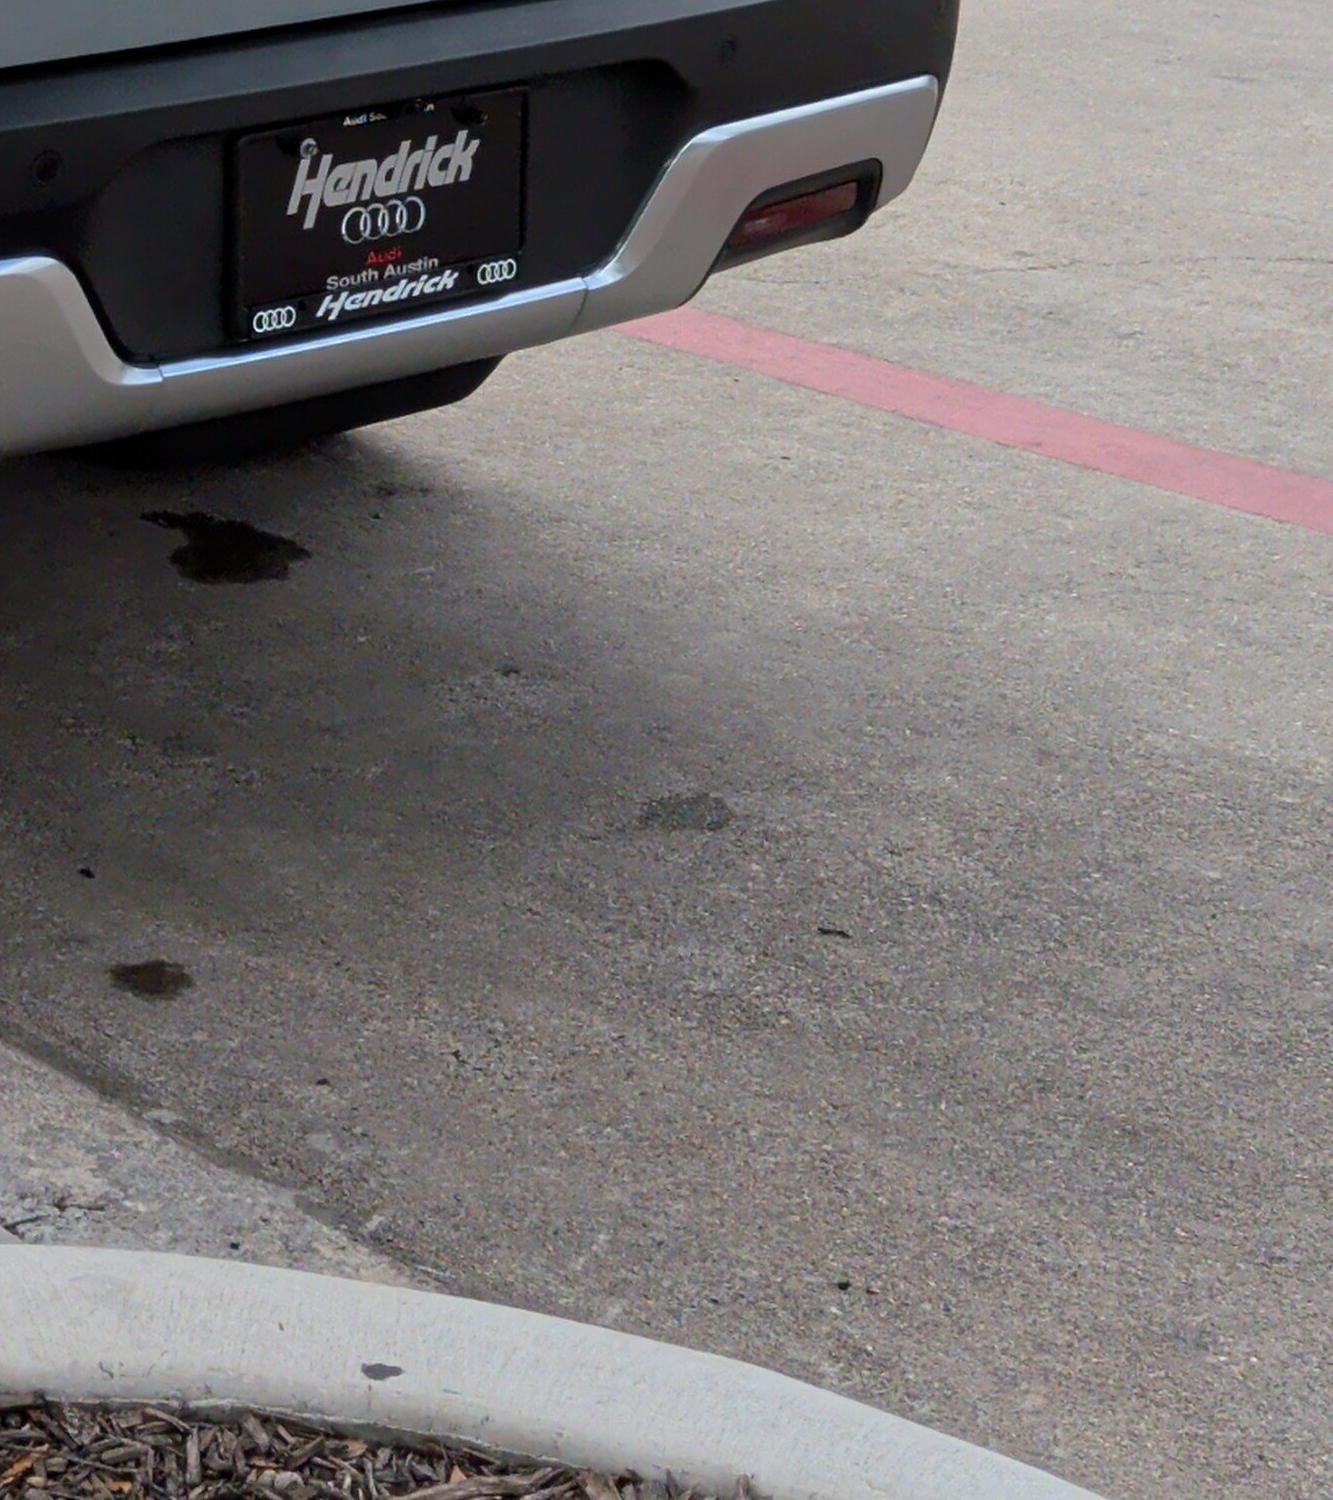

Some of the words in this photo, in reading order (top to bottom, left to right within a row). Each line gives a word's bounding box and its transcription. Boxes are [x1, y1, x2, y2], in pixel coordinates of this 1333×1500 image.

[286, 129, 481, 230] Hendrick
[326, 267, 379, 291] South
[383, 256, 439, 279] Austin
[366, 246, 402, 265] Audi
[315, 269, 460, 321] Hendrick
